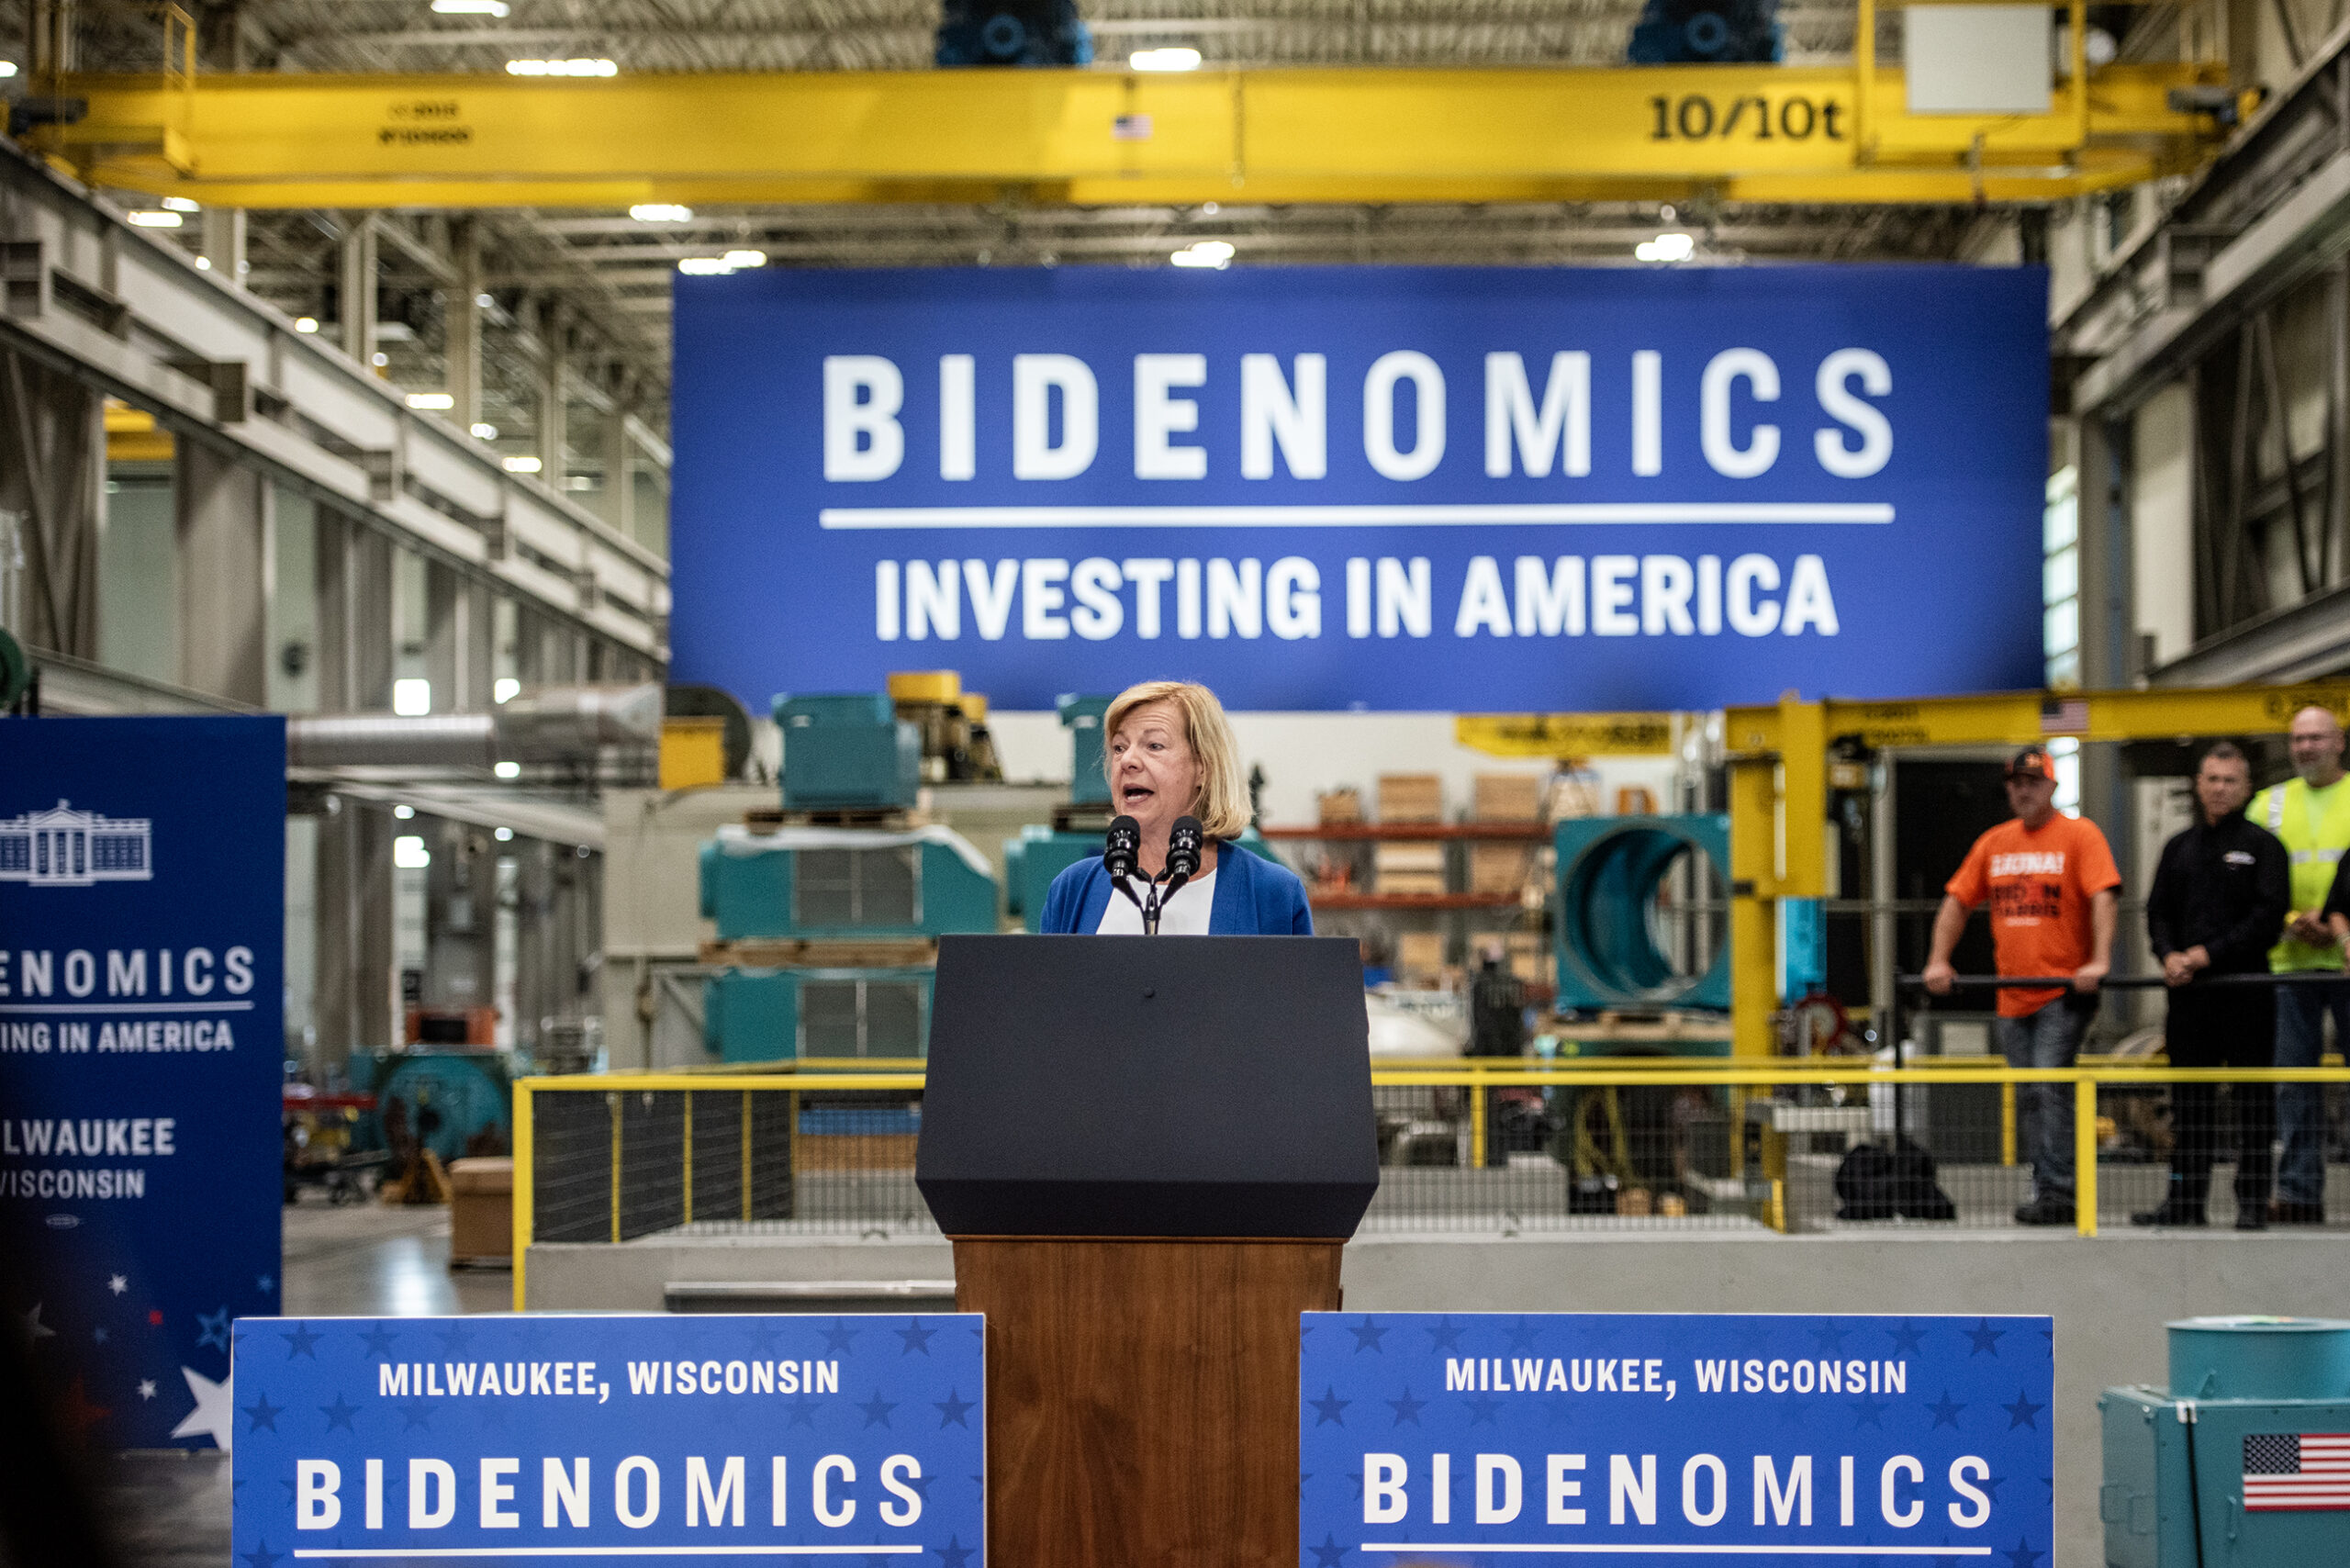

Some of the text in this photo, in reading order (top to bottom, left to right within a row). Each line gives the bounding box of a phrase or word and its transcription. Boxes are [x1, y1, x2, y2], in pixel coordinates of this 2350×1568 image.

[1649, 95, 1844, 140] 10/10t
[822, 347, 1895, 483] BIDENOMICS
[874, 553, 1841, 643] INVESTING IN AMERICA
[58, 1022, 90, 1053] IN
[97, 1019, 234, 1053] AMERICA
[3, 1117, 176, 1157] LWAUKEE
[378, 1359, 839, 1405] MILWAUKEE, WISCONSIN
[1445, 1357, 1907, 1402] MILWAUKEE, WISCONSIN
[296, 1453, 923, 1531] BIDENOMICS
[1362, 1452, 1992, 1529] BIDENOMICS
